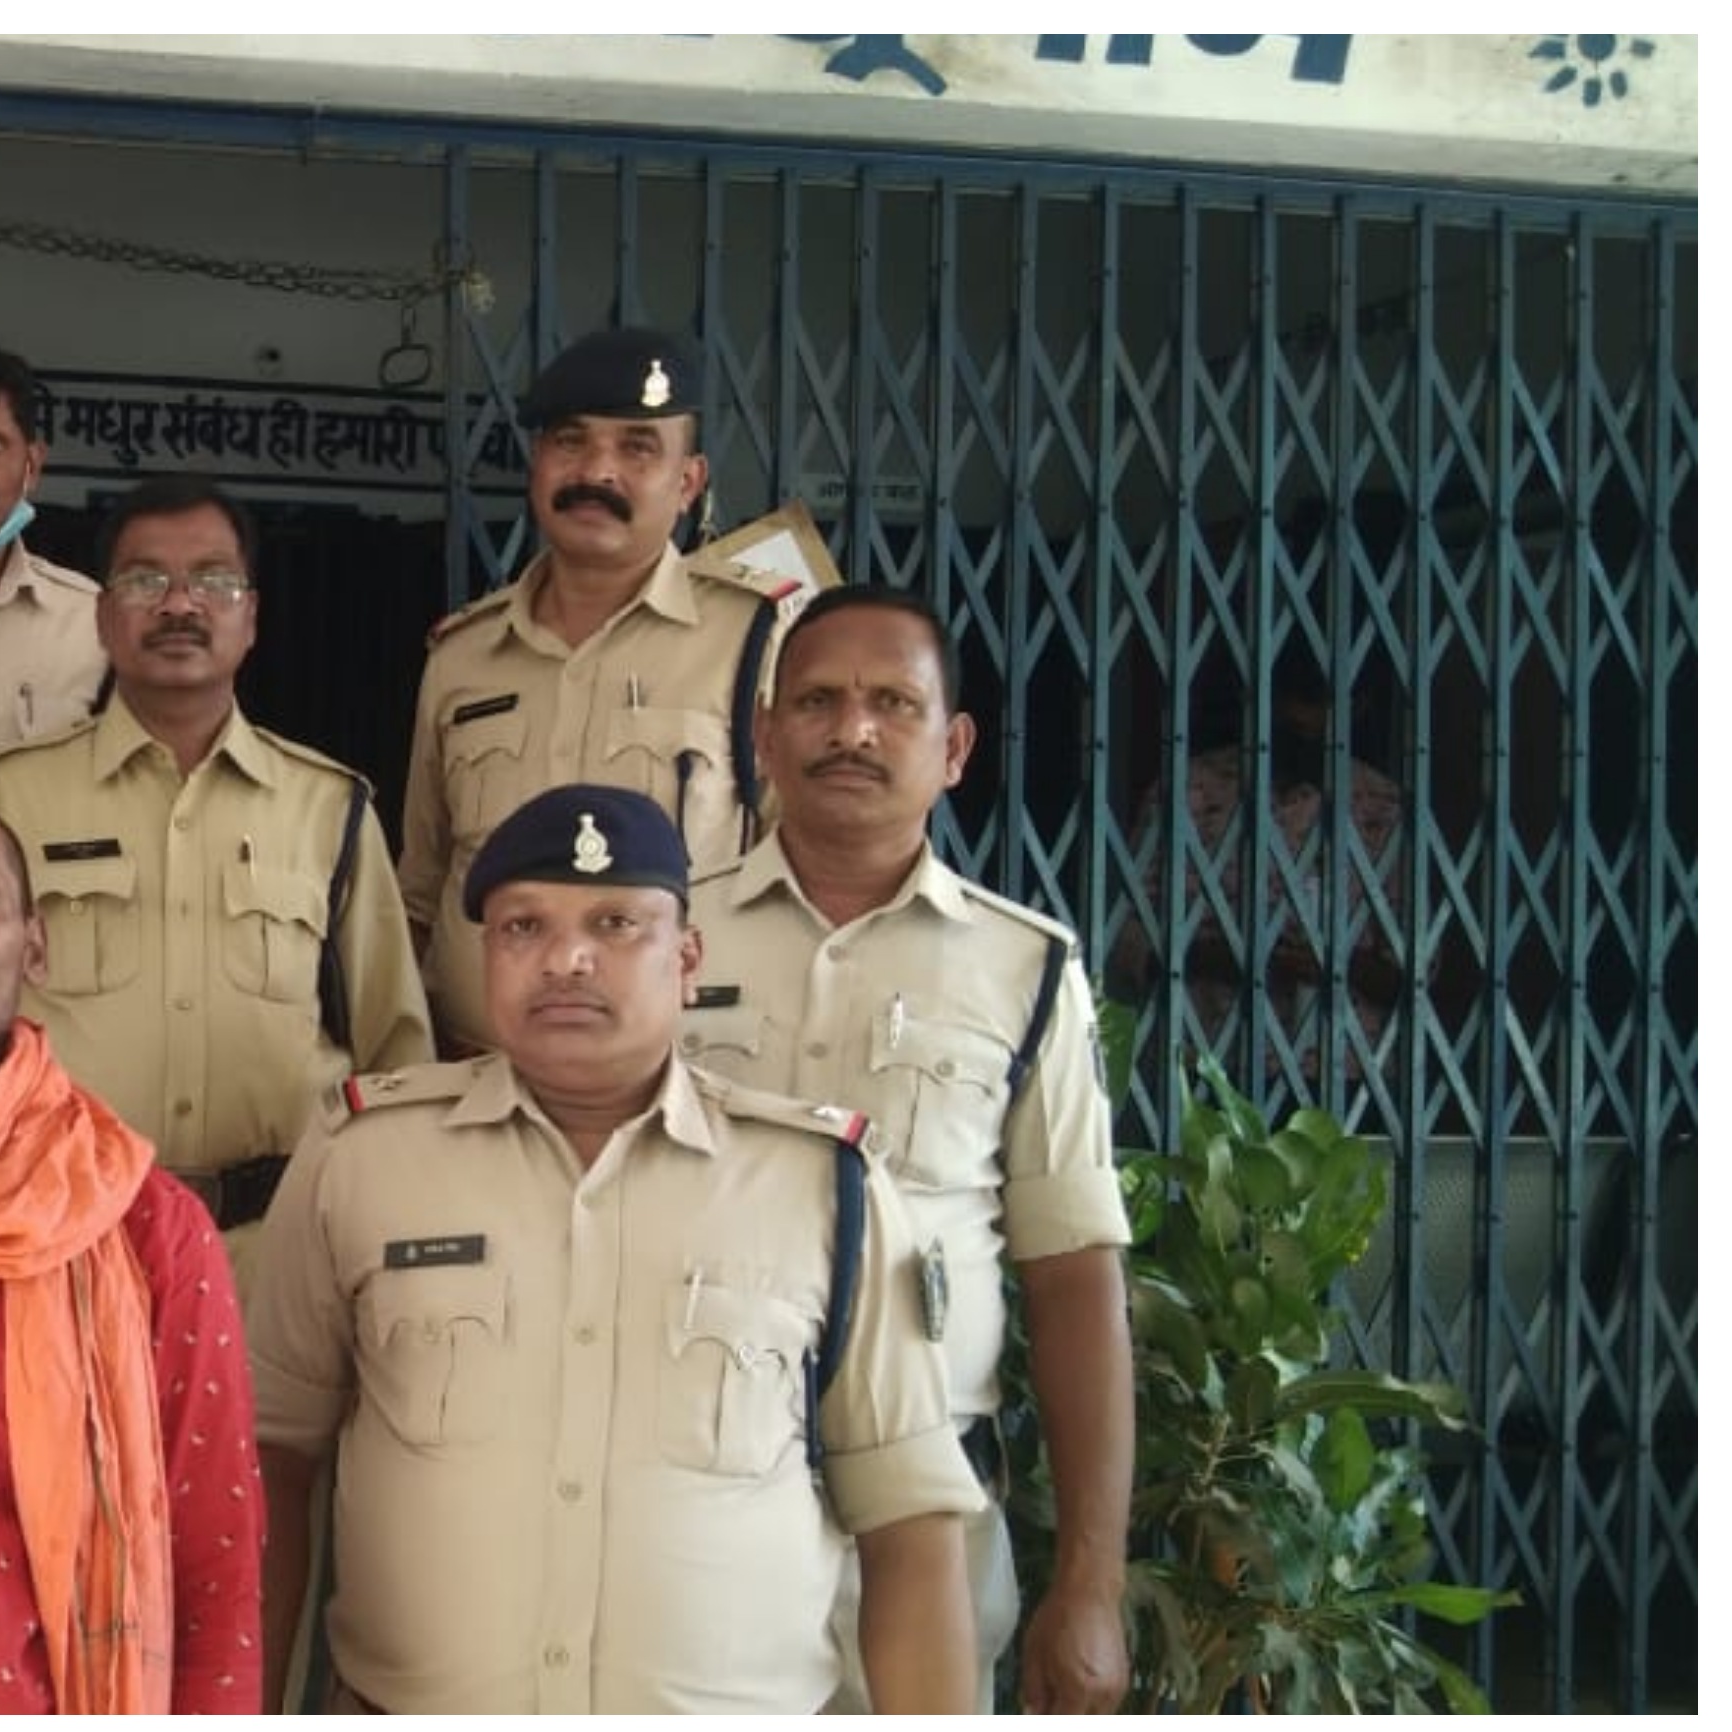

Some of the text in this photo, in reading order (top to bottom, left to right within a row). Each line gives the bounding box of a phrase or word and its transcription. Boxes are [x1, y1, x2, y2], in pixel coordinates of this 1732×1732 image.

[64, 397, 160, 466] मधुर
[163, 394, 265, 459] संबंध
[268, 398, 307, 469] ही
[315, 405, 419, 473] हमारी
